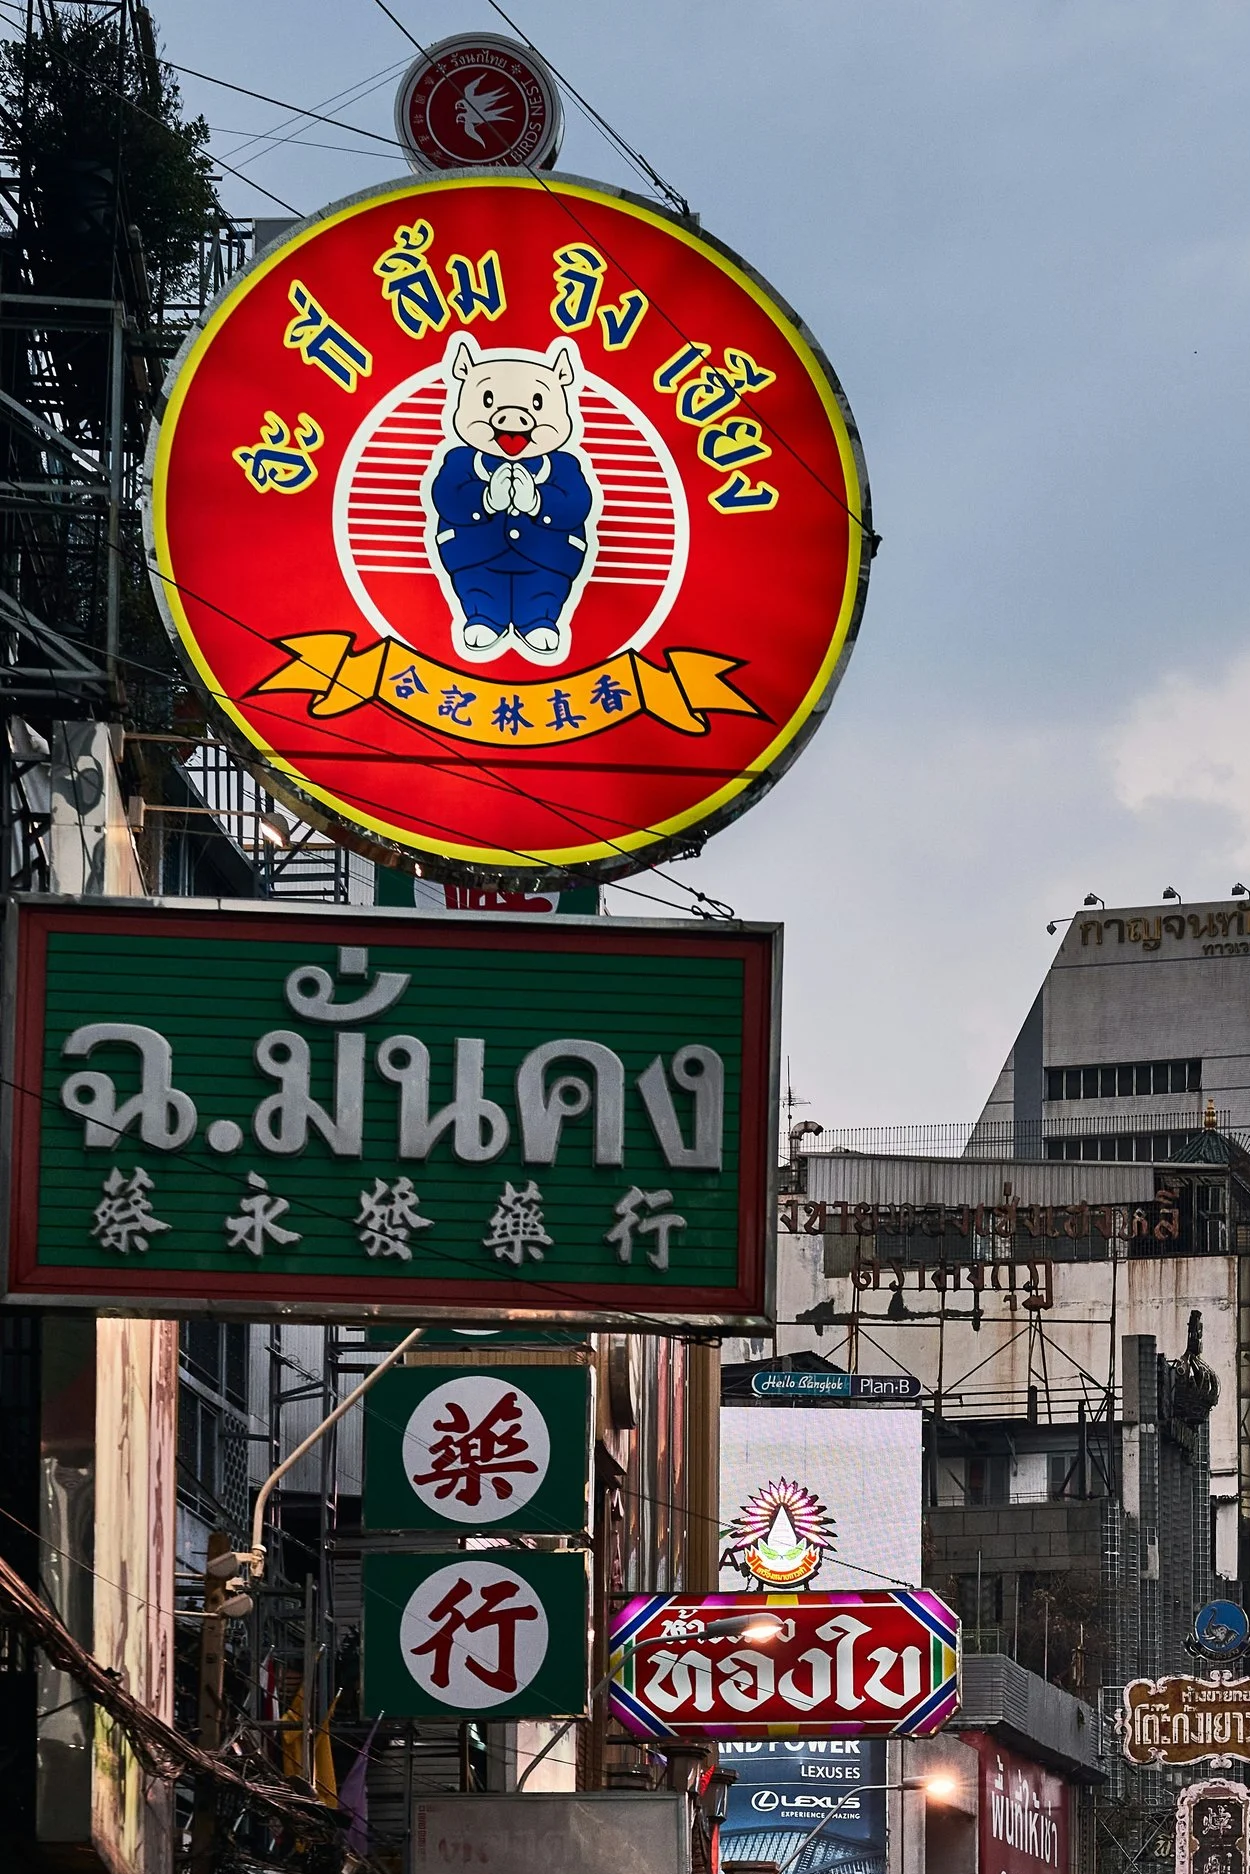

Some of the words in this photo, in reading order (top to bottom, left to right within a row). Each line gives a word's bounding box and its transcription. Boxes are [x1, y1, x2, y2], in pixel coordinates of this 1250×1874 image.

[451, 50, 508, 69] รังนกไทย
[520, 79, 544, 116] NEST
[510, 122, 542, 164] BIRDS
[373, 218, 507, 340] ลิ้ม
[551, 242, 649, 352] จิง
[59, 945, 725, 1169] ฉ.มั่นคง
[91, 1165, 688, 1272] 蔡永發藥行
[643, 1614, 923, 1713] ทองใบ
[781, 1796, 861, 1809] LEXUS
[801, 1765, 843, 1778] LEXUS
[845, 1767, 861, 1779] ES
[991, 1754, 1059, 1868] พื้นที่ให้เช่า
